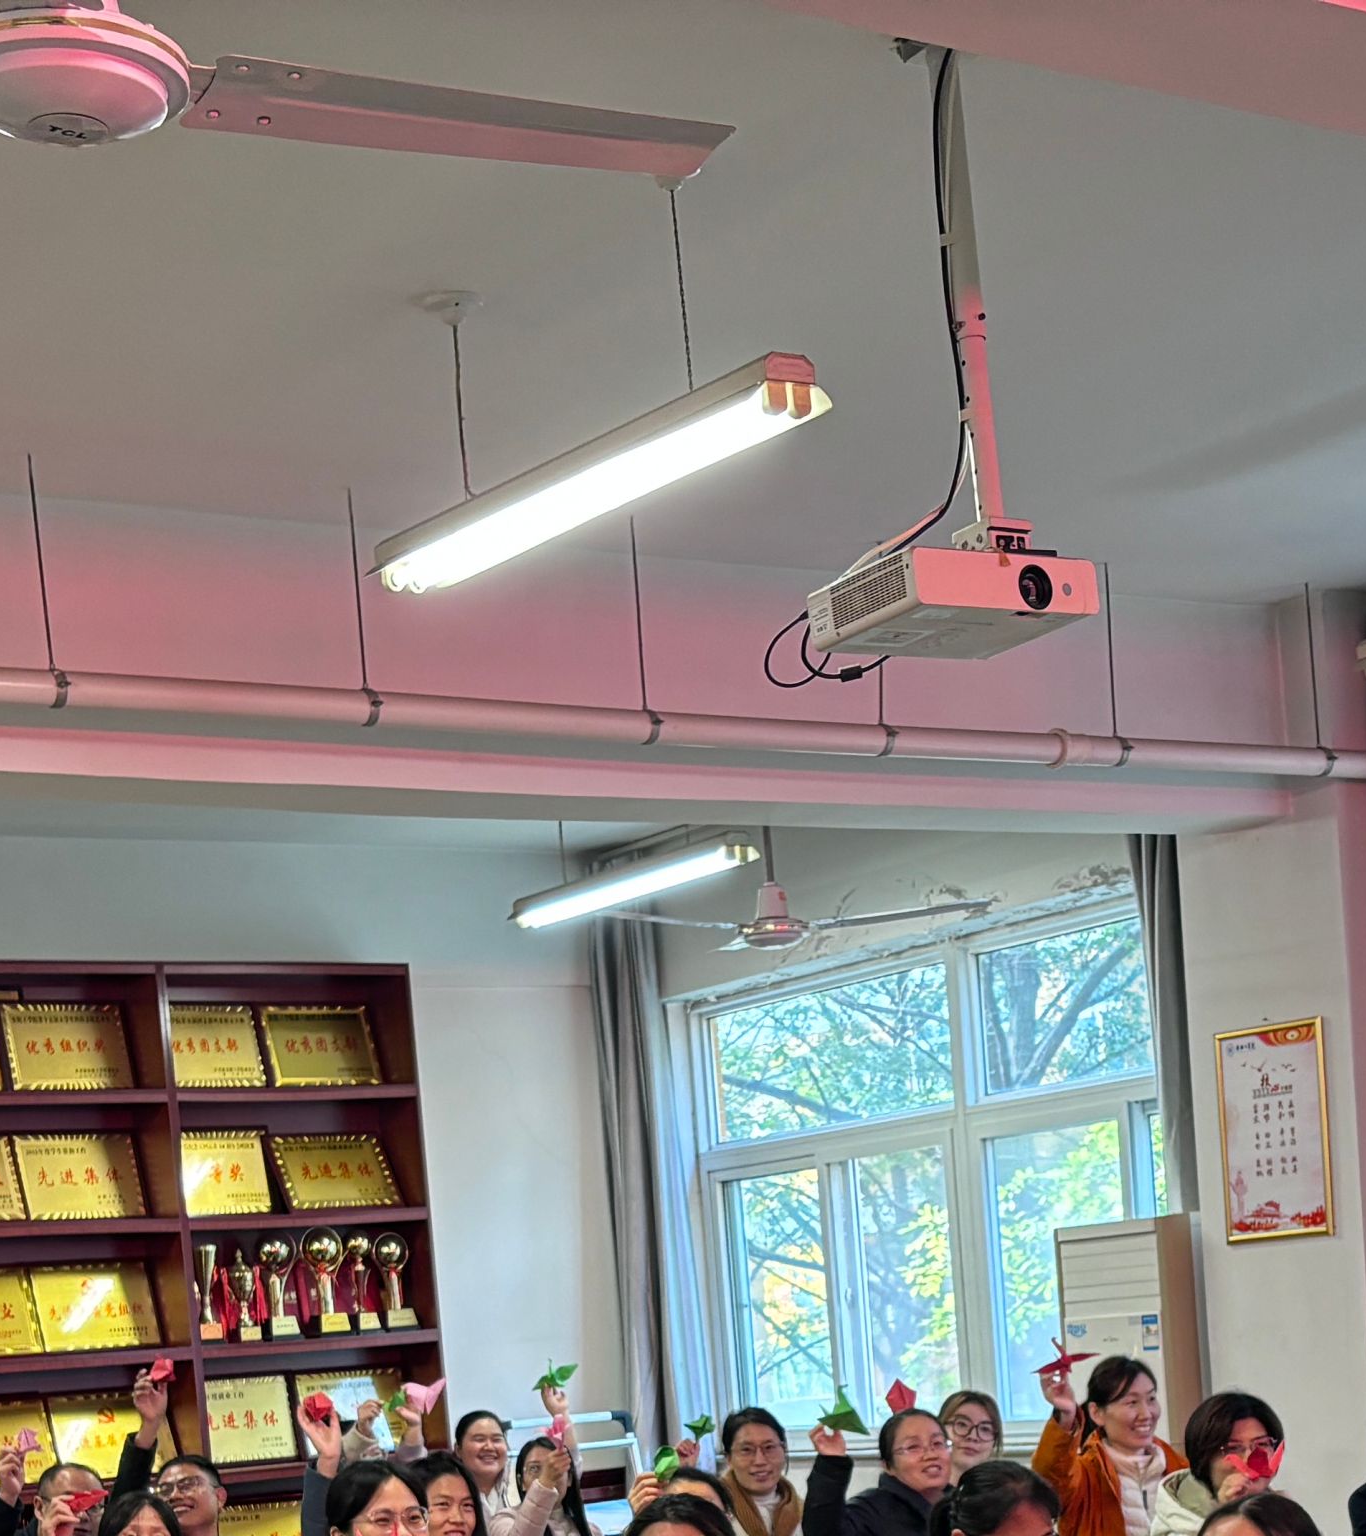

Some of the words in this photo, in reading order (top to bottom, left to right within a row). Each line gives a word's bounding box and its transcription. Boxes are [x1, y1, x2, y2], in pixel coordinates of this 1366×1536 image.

[49, 124, 87, 139] TCL
[26, 1037, 106, 1056] 优秀组织奖
[37, 1166, 123, 1188] 先进集体
[301, 1161, 375, 1181] 先进集体
